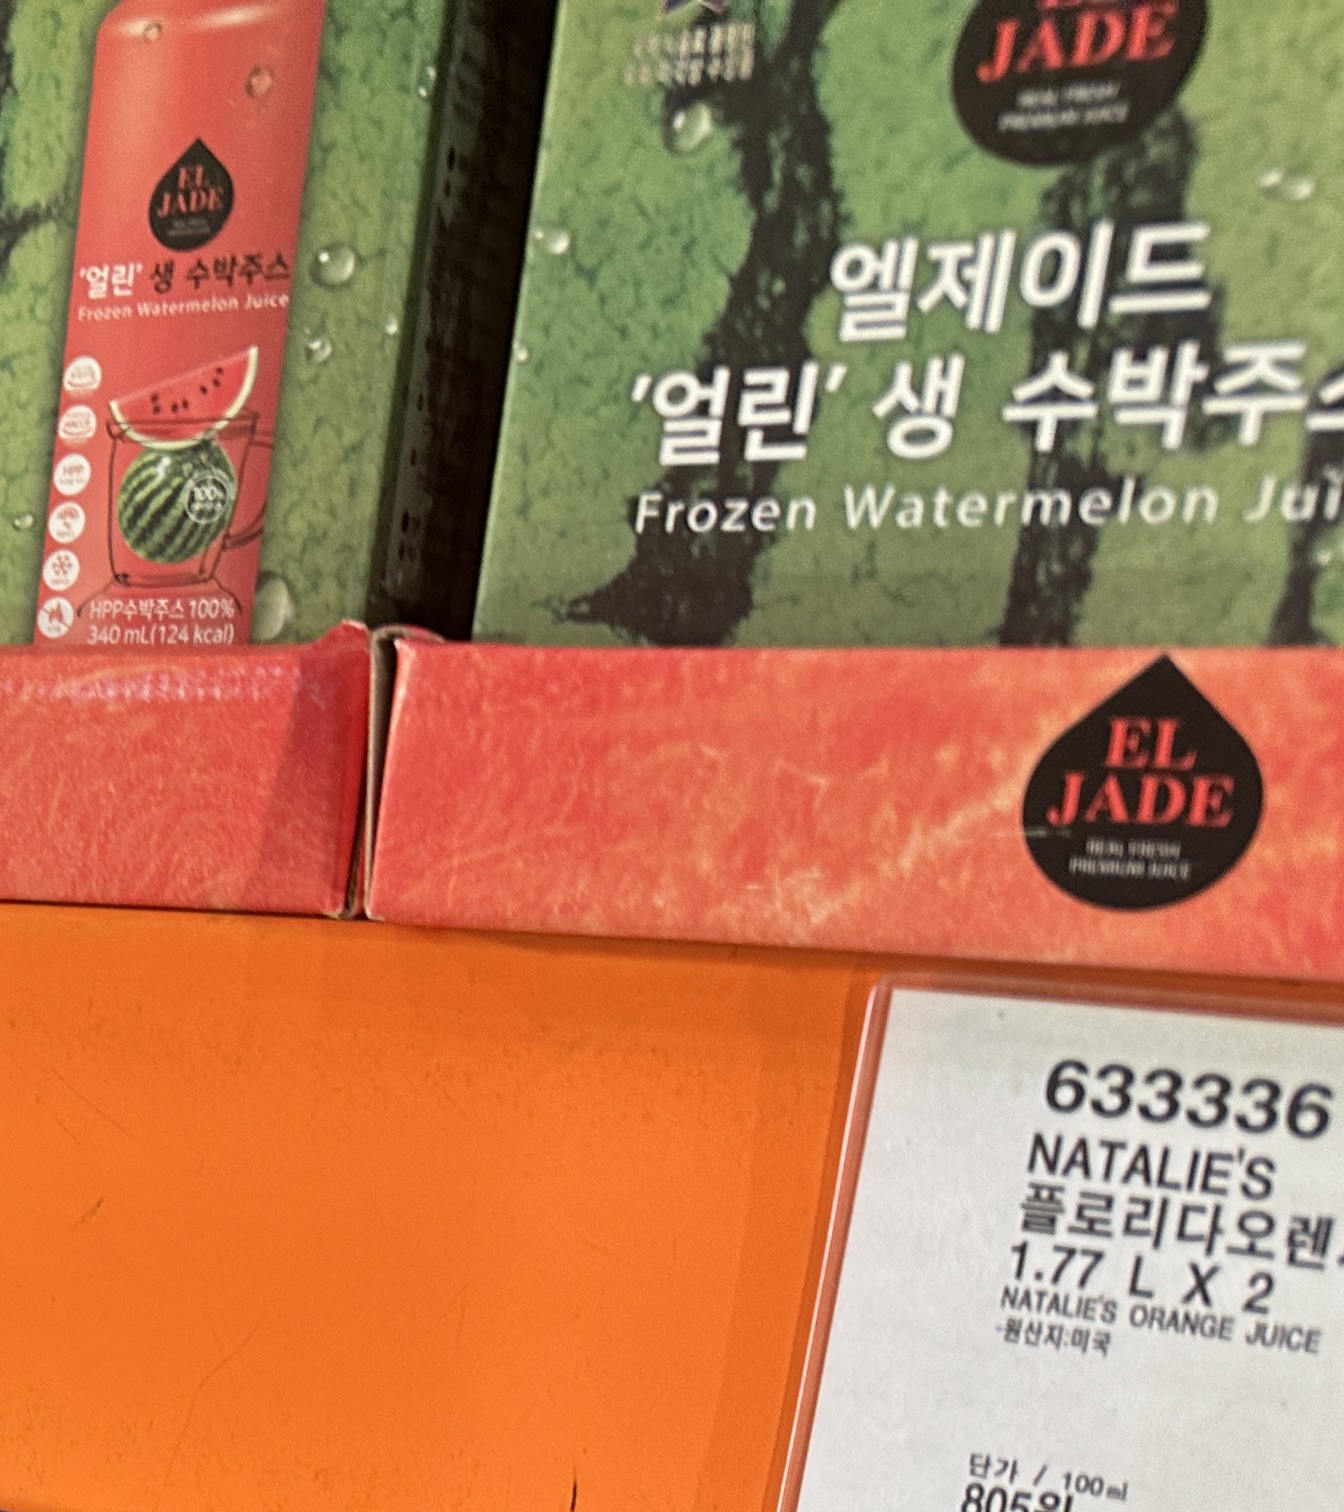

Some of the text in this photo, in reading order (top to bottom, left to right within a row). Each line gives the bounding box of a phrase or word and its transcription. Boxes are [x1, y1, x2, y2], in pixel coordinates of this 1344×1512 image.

[976, 3, 1179, 84] JADE
[156, 187, 224, 218] JADE
[150, 259, 175, 294] 생
[186, 250, 292, 290] 수박주스
[831, 219, 1212, 342] 엘제이드
[78, 292, 290, 323] Frozen Watermelon Juice
[872, 354, 966, 461] 생
[634, 469, 1344, 535] Frozen Watermelon Jui
[87, 624, 121, 646] 340
[193, 624, 235, 646] kcal)
[190, 598, 235, 620] 100%
[1105, 716, 1198, 770] EL
[1045, 770, 1235, 827] JADE
[1045, 1058, 1334, 1141] 633336
[1027, 1131, 1277, 1201] NATALIE'S
[1020, 1181, 1344, 1271] 플로리다오렌
[1010, 1240, 1276, 1315] 1.77 L X 2
[1000, 1284, 1323, 1355] NATALIE'S ORANGE JUICE
[969, 1452, 1018, 1485] 단가
